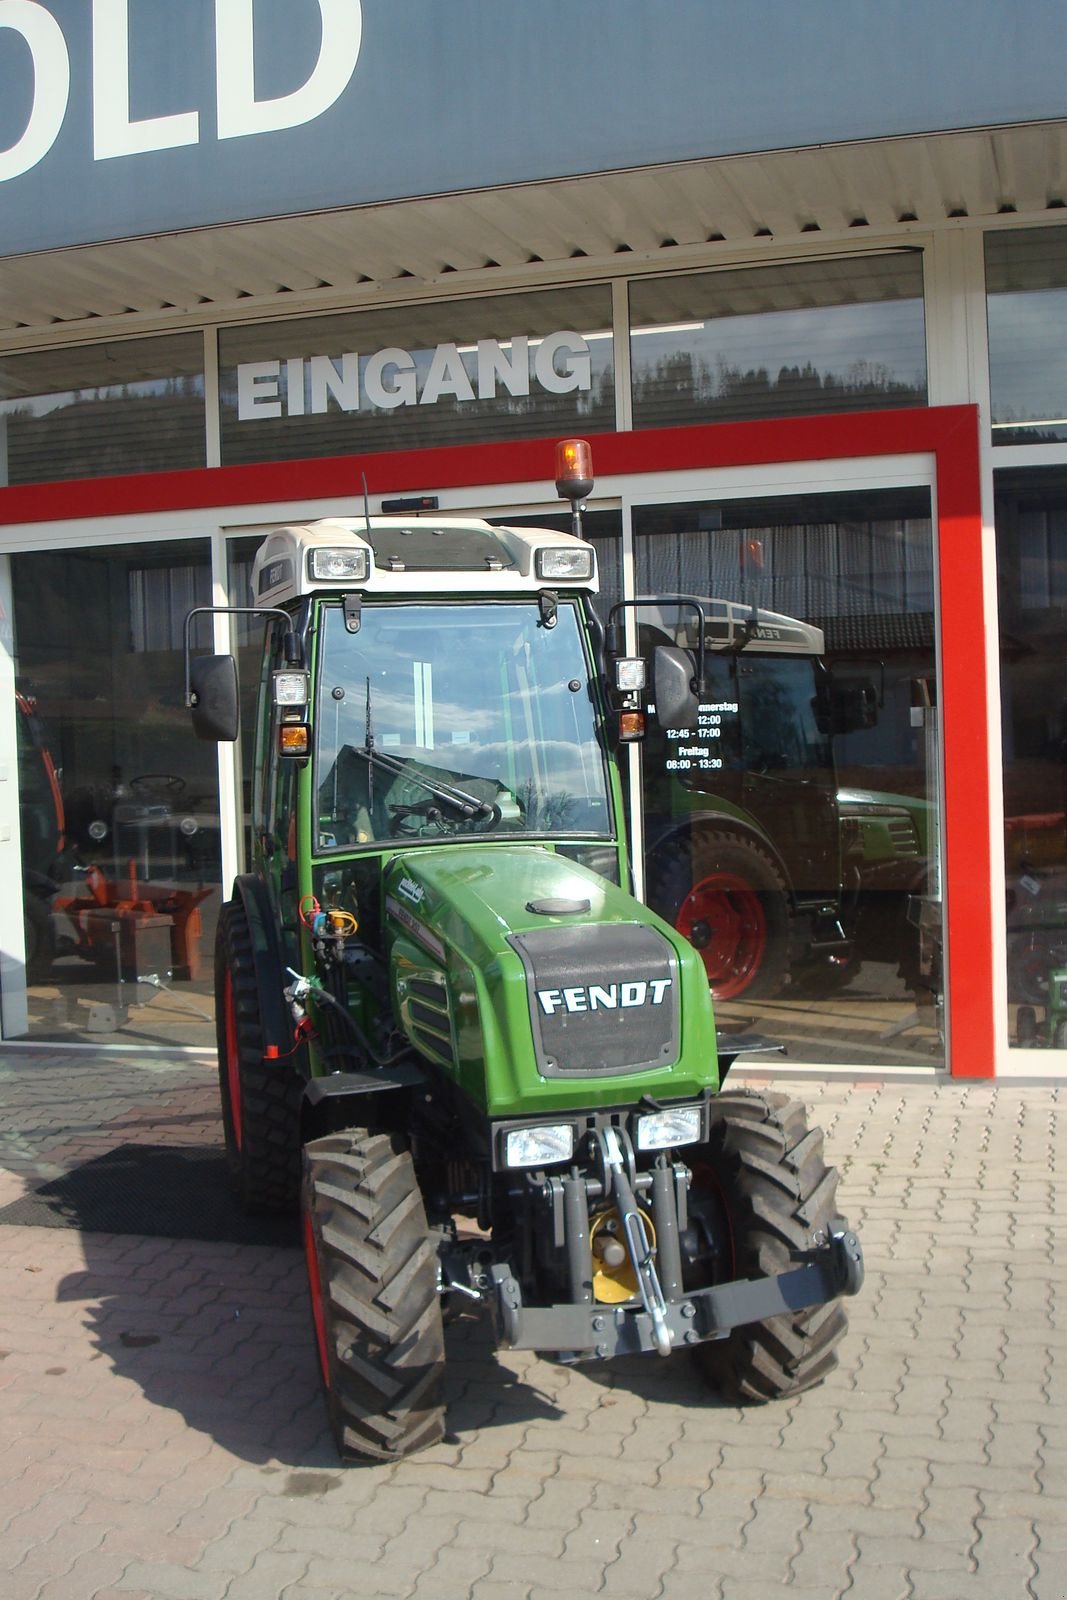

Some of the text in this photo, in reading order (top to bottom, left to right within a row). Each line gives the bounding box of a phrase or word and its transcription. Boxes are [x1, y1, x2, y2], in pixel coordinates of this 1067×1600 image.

[237, 331, 592, 421] EINGANG
[697, 715, 721, 725] 12:00
[666, 729, 690, 739] 12:45
[697, 728, 721, 738] 17:00
[678, 746, 709, 757] Freitag
[666, 759, 691, 769] 08:00
[698, 759, 722, 769] 13:30
[536, 978, 673, 1015] FENDT
